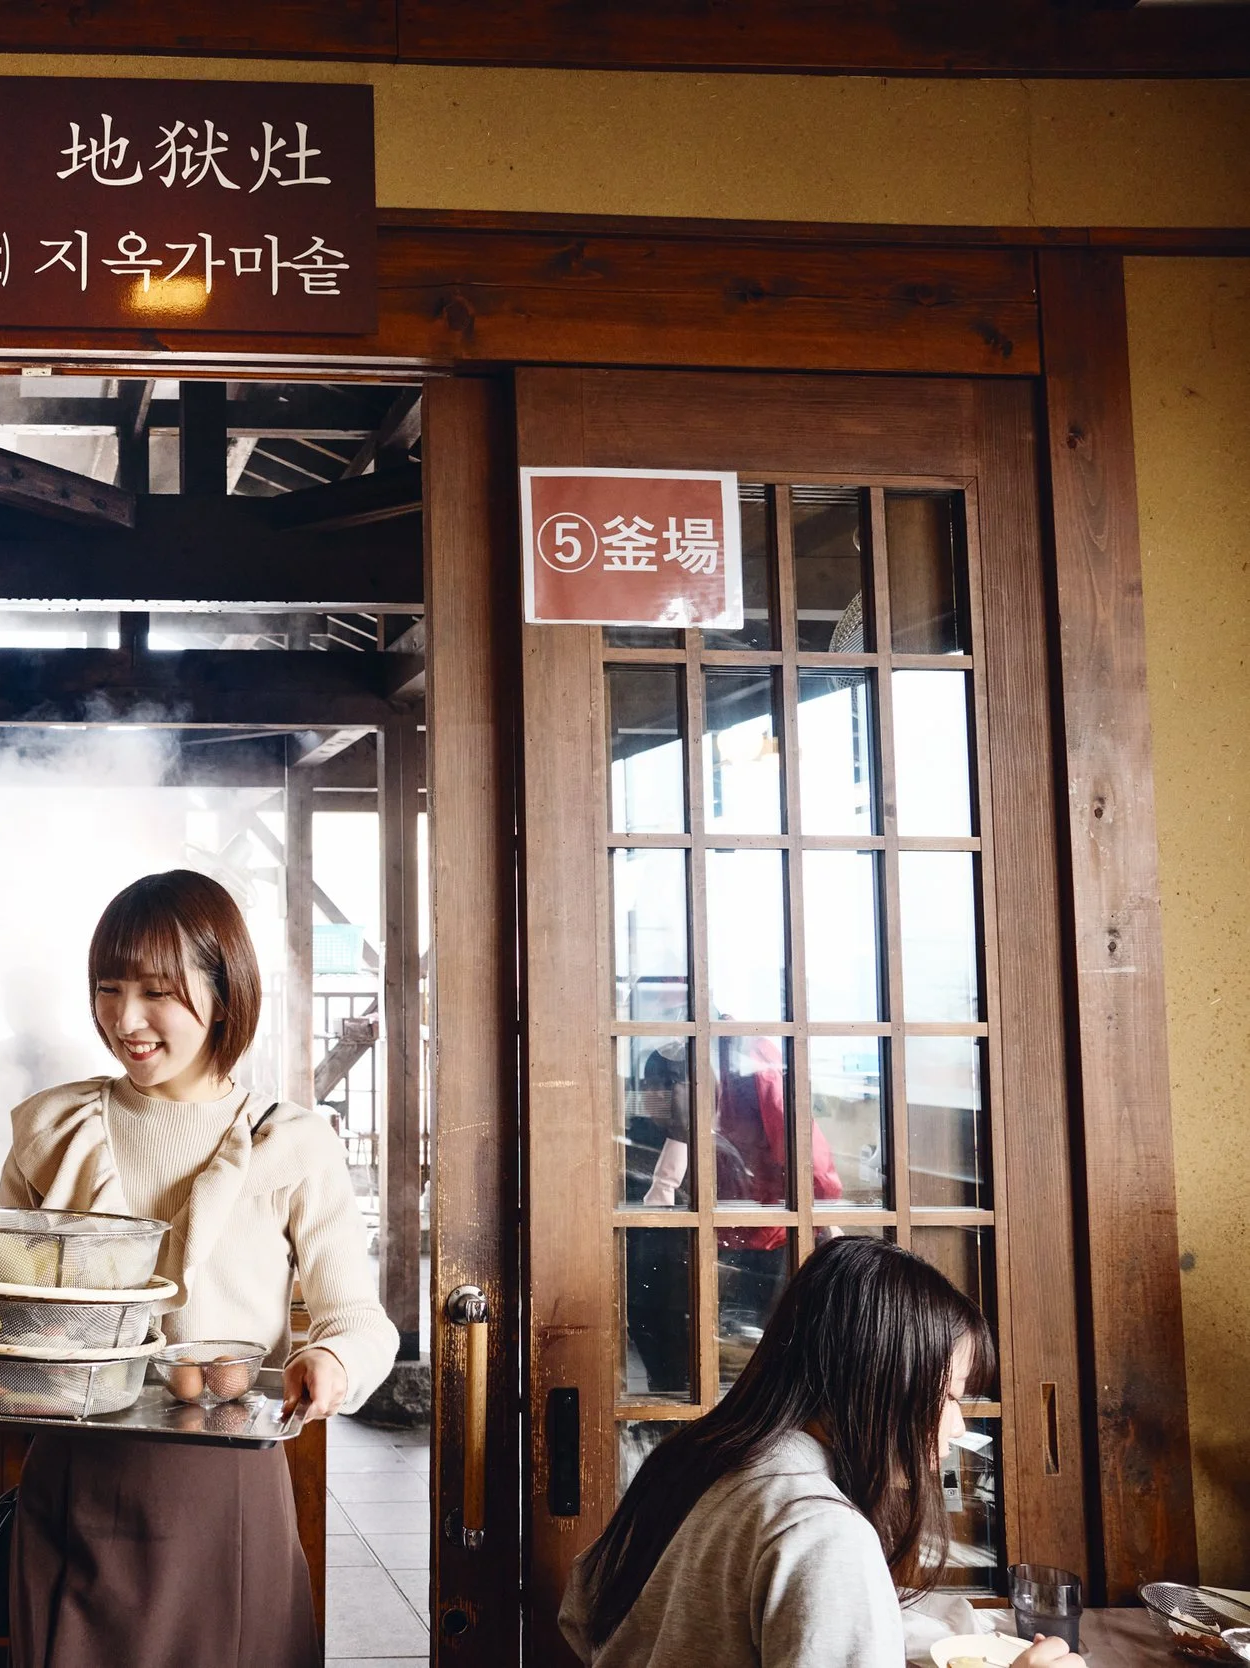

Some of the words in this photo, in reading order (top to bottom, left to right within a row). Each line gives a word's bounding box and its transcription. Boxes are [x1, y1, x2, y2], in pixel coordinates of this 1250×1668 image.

[56, 113, 332, 194] 地狱灶
[34, 229, 350, 296] 지옥가마솥
